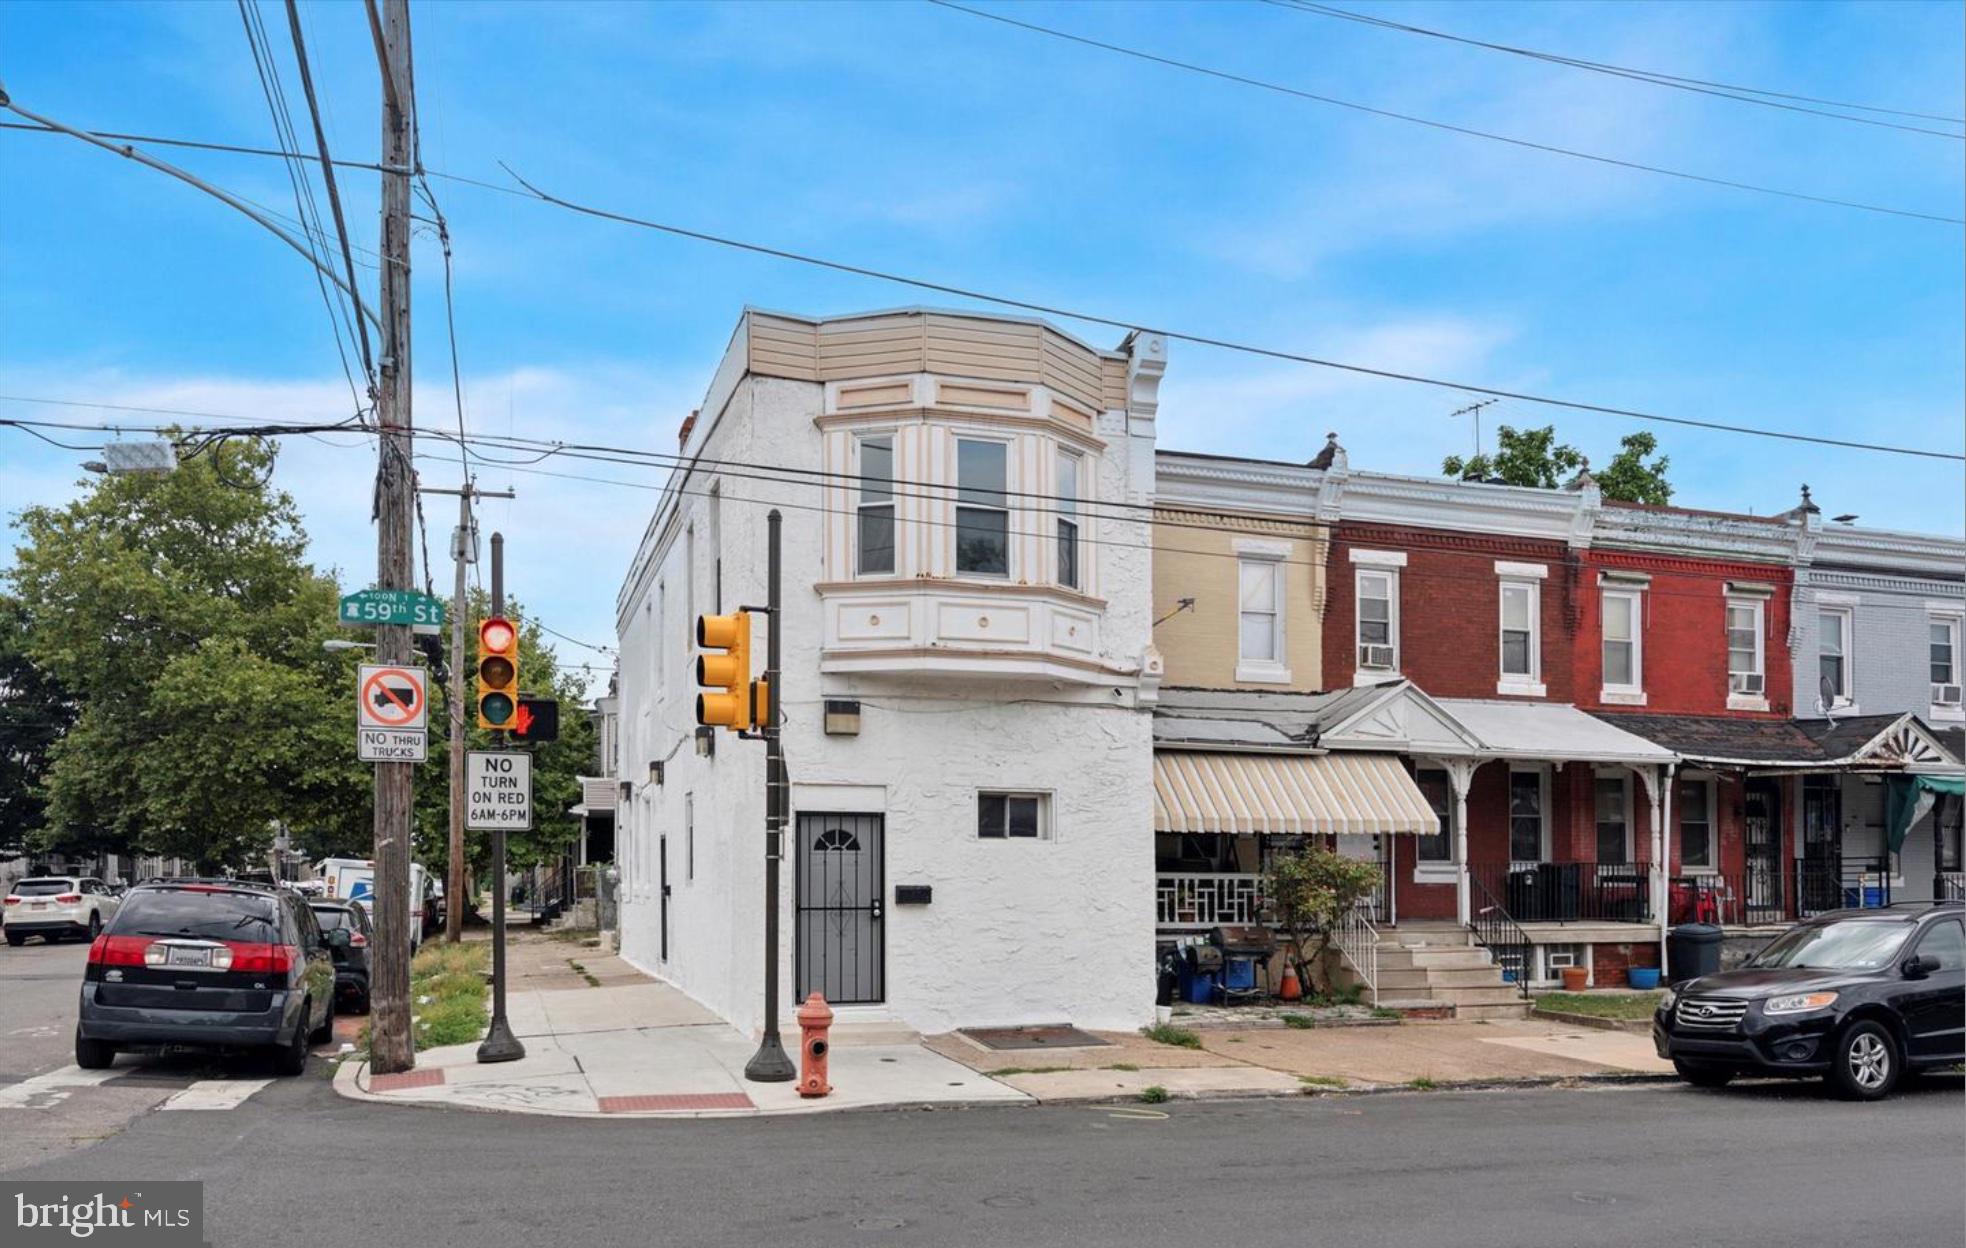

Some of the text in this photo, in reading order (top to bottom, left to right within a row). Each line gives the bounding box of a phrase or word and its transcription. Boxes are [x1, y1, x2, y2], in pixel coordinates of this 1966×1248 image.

[364, 602, 439, 623] 59th St
[365, 732, 421, 746] NO THRU
[372, 747, 415, 757] TRUCKS
[485, 758, 512, 773] NO
[480, 776, 518, 788] TURN
[472, 791, 526, 805] ON RED
[470, 808, 527, 822] 6AM-6PM
